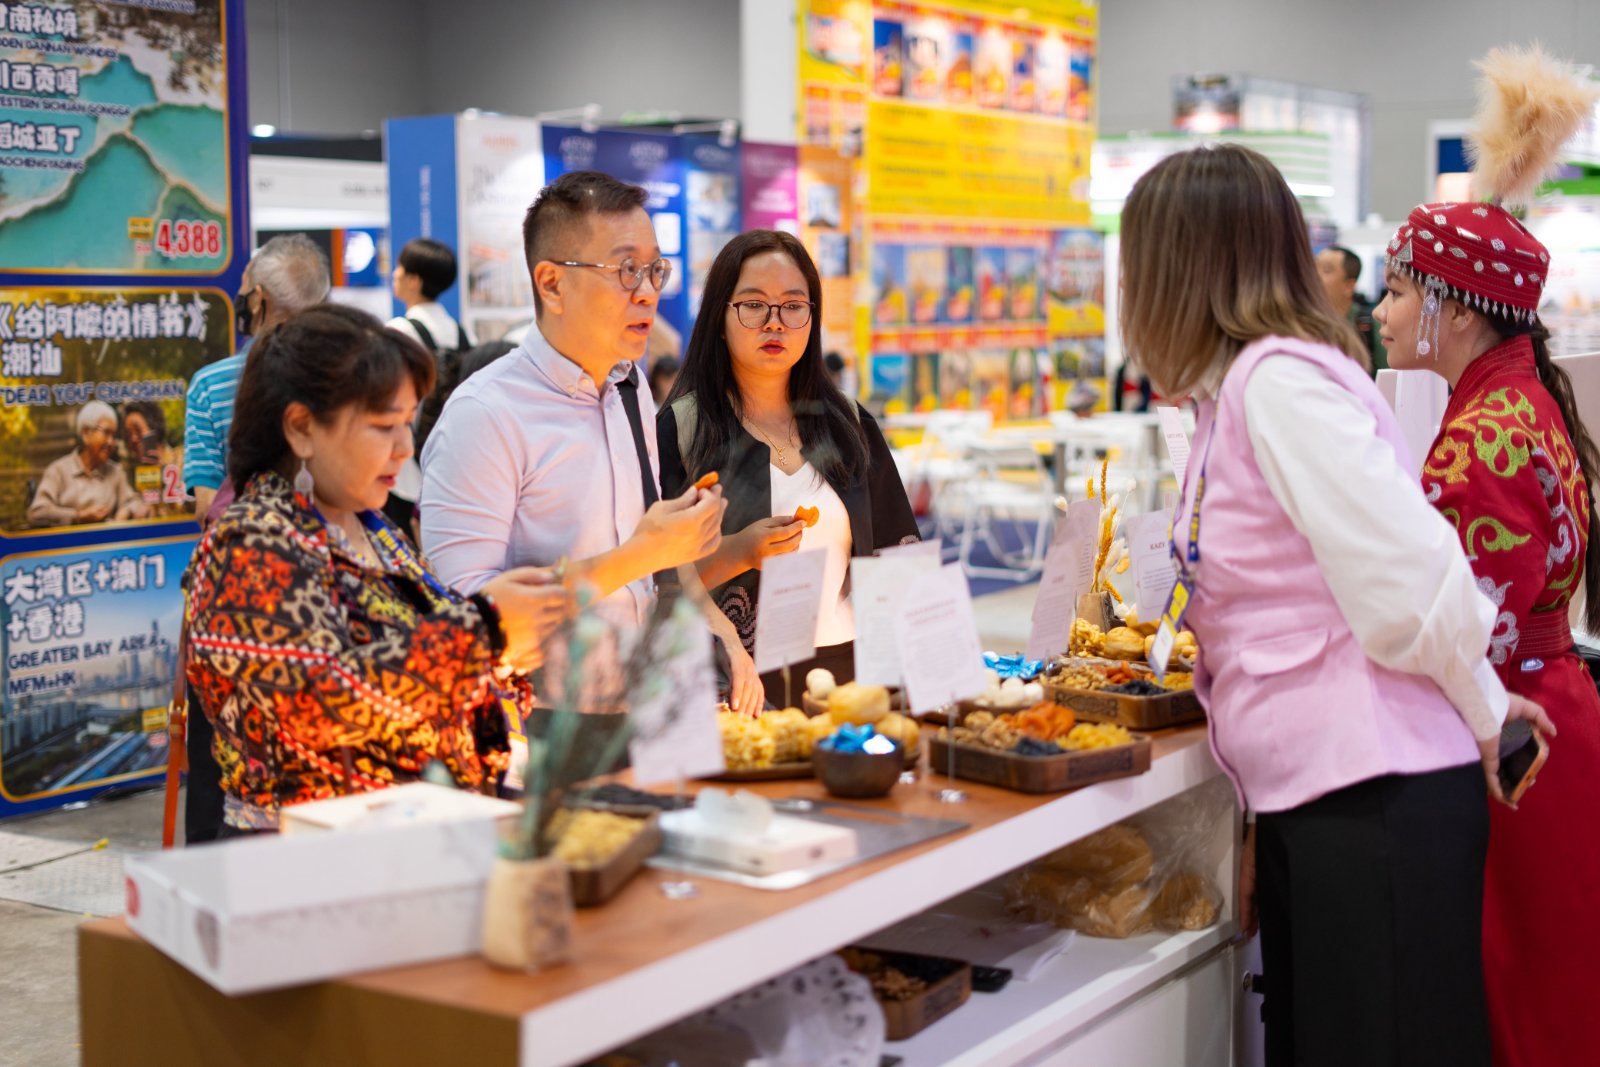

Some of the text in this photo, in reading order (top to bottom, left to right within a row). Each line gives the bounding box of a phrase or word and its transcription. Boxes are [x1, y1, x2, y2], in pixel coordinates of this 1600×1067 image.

[156, 220, 222, 259] 4,388
[2, 341, 62, 376] 潮汕
[97, 378, 185, 402] CHAOSHAN
[4, 553, 165, 605] 大湾区+澳门
[7, 601, 84, 642] +香港
[9, 645, 79, 670] GREATER
[83, 640, 113, 660] BAY
